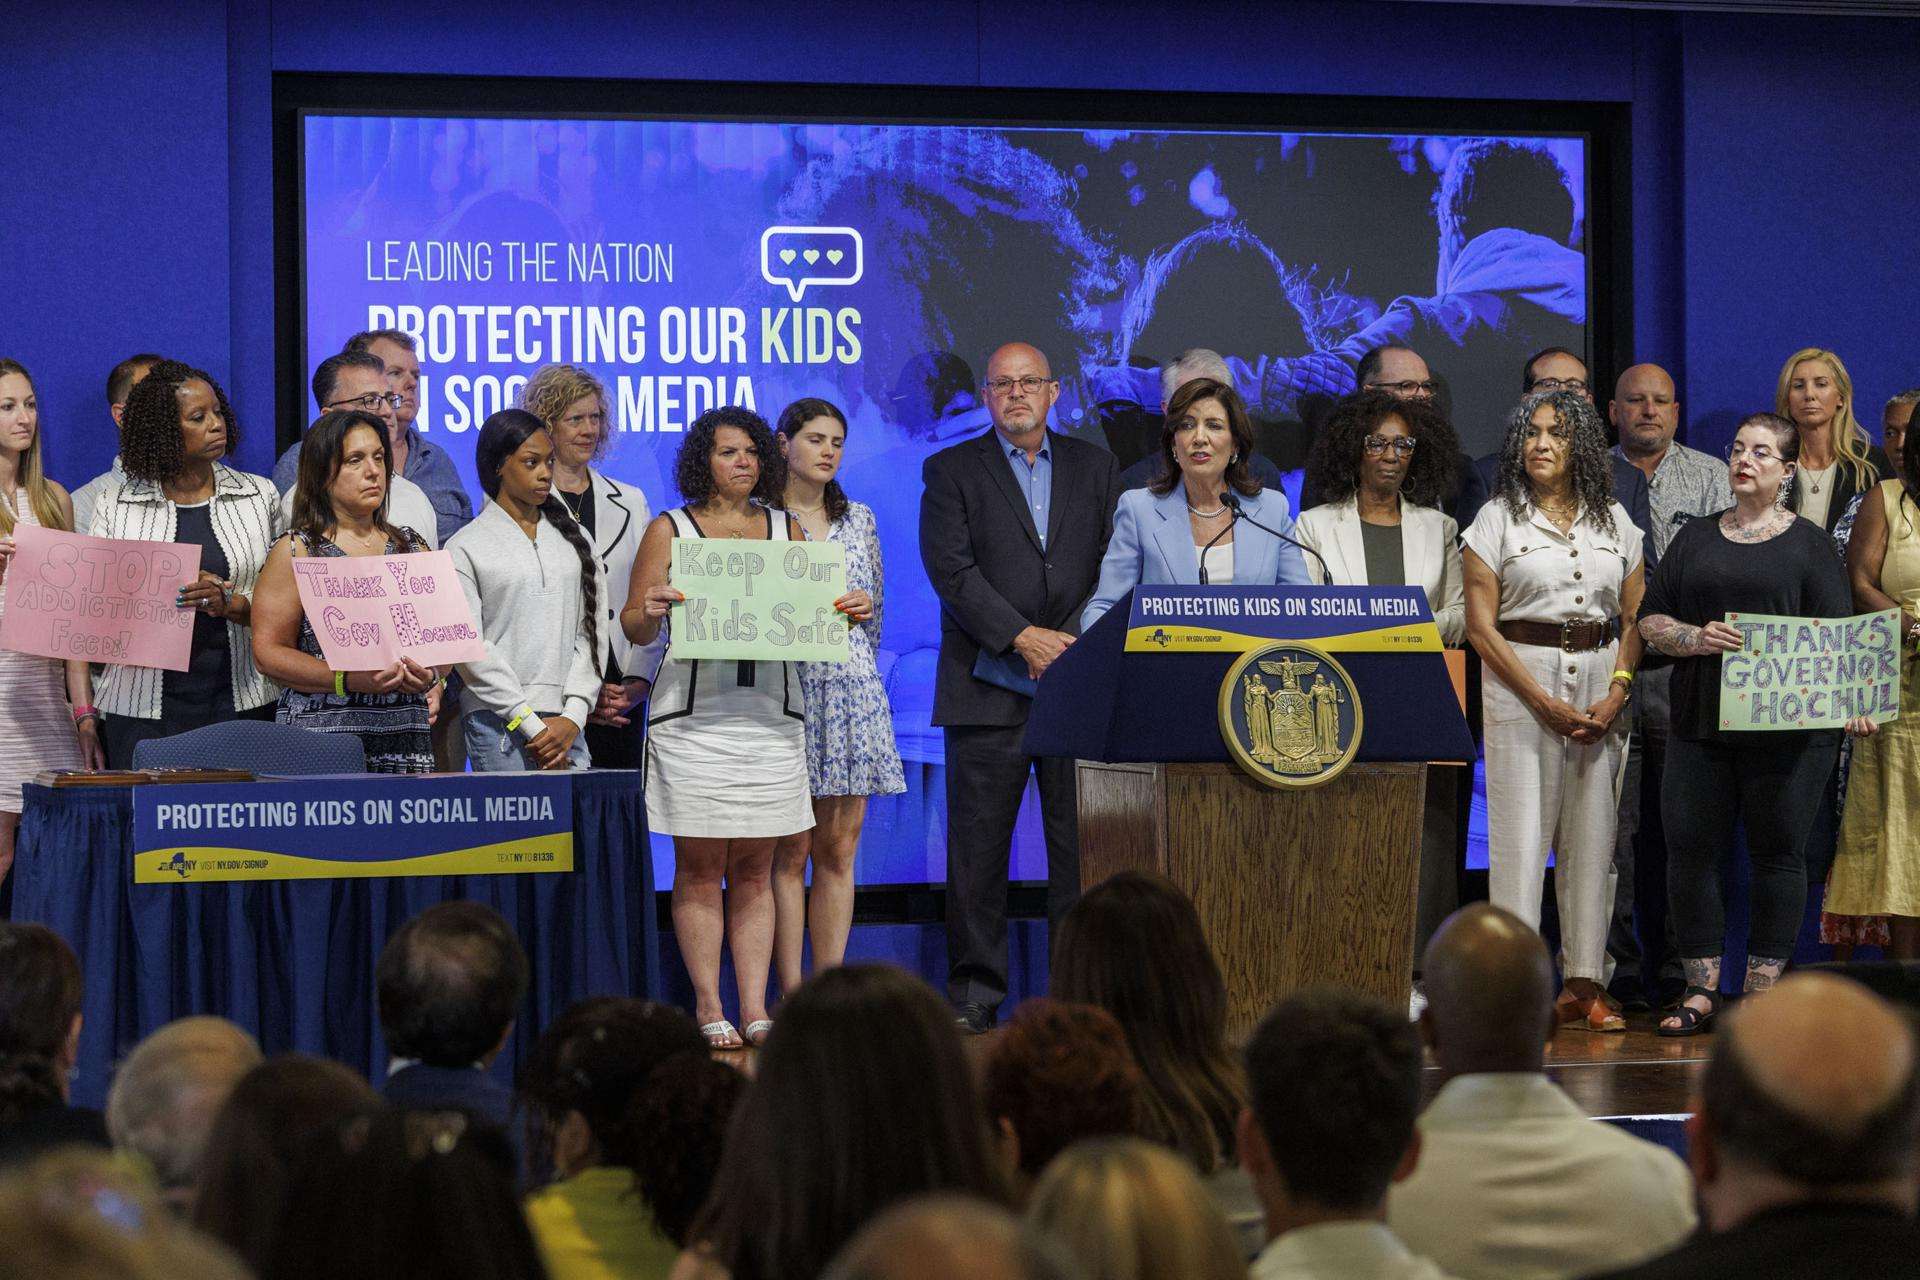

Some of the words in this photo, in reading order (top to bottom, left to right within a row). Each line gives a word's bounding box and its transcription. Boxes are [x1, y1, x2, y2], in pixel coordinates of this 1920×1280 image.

[367, 240, 492, 282] LEADING
[502, 241, 558, 282] THE
[568, 243, 674, 283] NATION
[660, 306, 747, 364] OUR
[761, 307, 862, 365] KIDS
[40, 543, 182, 596] STOP
[679, 543, 765, 596] Keep
[784, 545, 840, 582] Our
[685, 598, 758, 642] Kids
[765, 602, 844, 646] Safe
[1142, 597, 1240, 617] PROTECTING
[1245, 598, 1280, 616] KIDS
[1286, 598, 1307, 616] ON
[1311, 598, 1367, 616] SOCIAL
[1371, 598, 1420, 616] MEDIA
[1734, 615, 1893, 654] THANKS
[1722, 650, 1899, 689] GOVERNOR
[1751, 683, 1898, 724] HOCHUL
[157, 801, 297, 830] PROTECTING
[305, 801, 356, 827] KIDS
[363, 799, 393, 825] ON
[400, 797, 478, 824] SOCIAL
[485, 796, 554, 822] MEDIA
[185, 860, 197, 870] NY
[200, 860, 216, 870] VISIT
[217, 859, 269, 870] NY.GOV/SIGNUP
[497, 853, 513, 862] TEXT
[514, 853, 522, 862] NY
[533, 852, 554, 862] 81336
